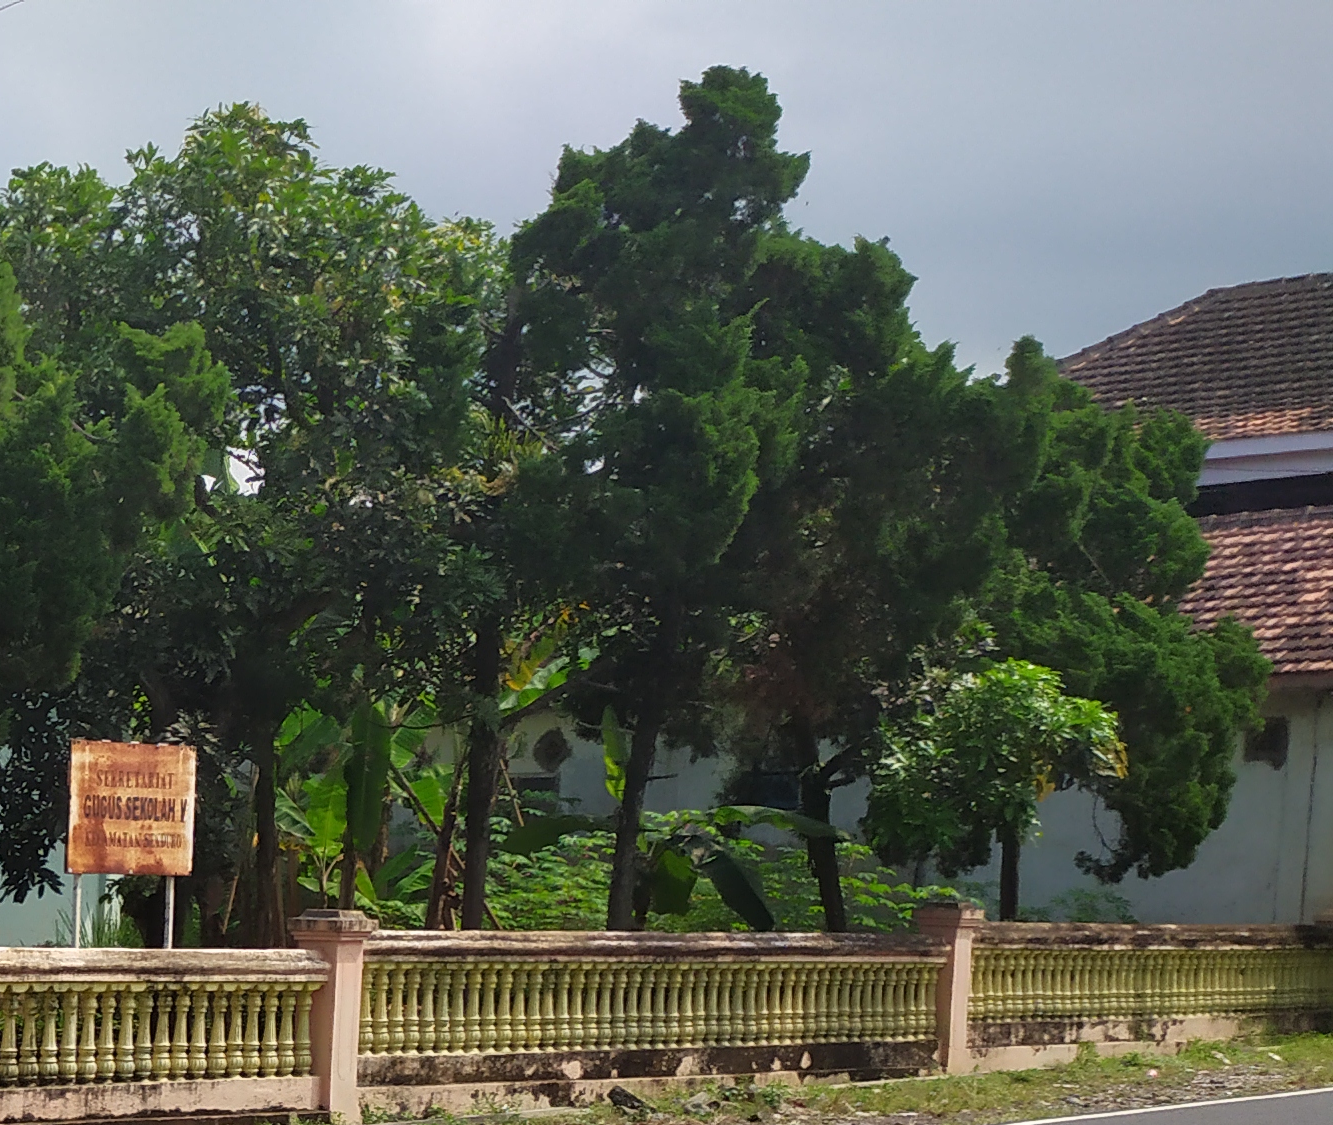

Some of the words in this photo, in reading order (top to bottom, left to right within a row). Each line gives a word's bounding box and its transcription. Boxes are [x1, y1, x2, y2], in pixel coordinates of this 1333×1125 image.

[96, 769, 174, 790] SEKRETARIAT
[83, 794, 123, 820] GUGUS
[124, 796, 176, 822] SEKOLAH
